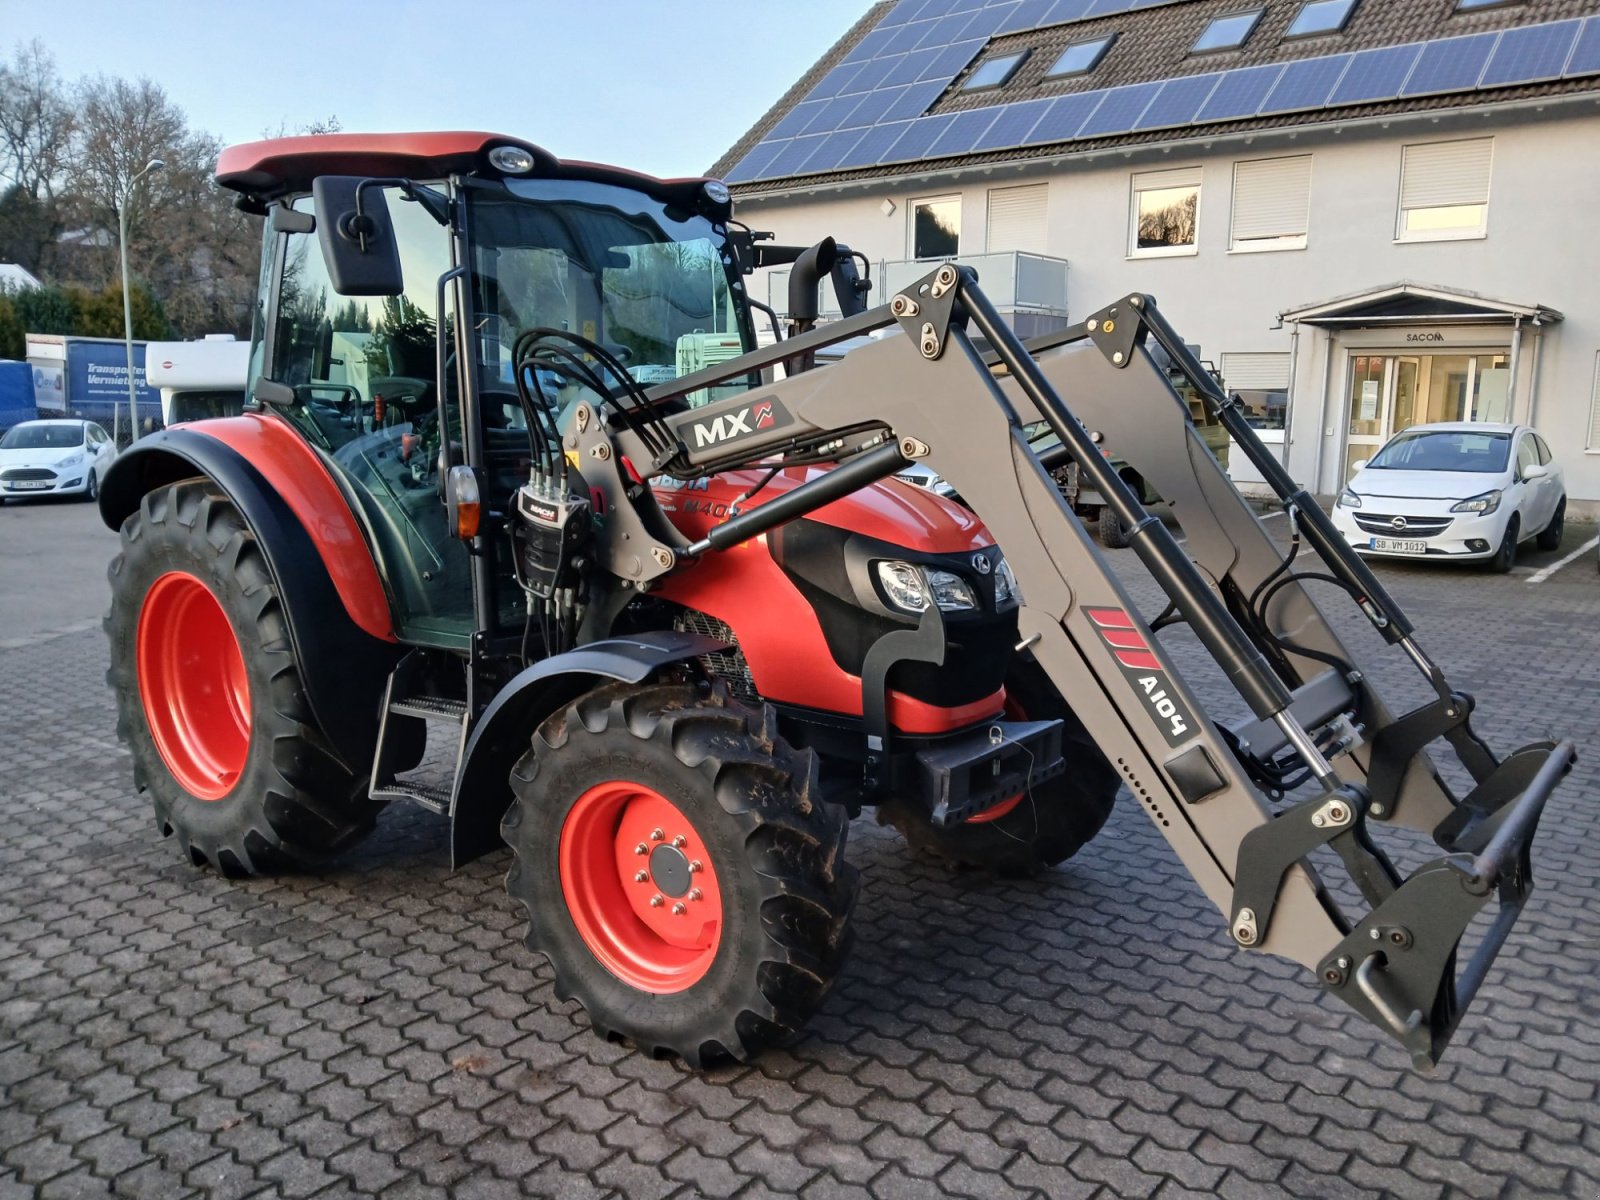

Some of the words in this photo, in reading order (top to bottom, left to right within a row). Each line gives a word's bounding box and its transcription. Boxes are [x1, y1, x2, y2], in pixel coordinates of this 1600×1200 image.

[1406, 332, 1444, 341] SACOM
[88, 363, 146, 375] Transpoter
[88, 374, 146, 387] Vermietng
[693, 408, 753, 448] MX
[1376, 540, 1387, 549] SB
[1138, 676, 1188, 737] A104
